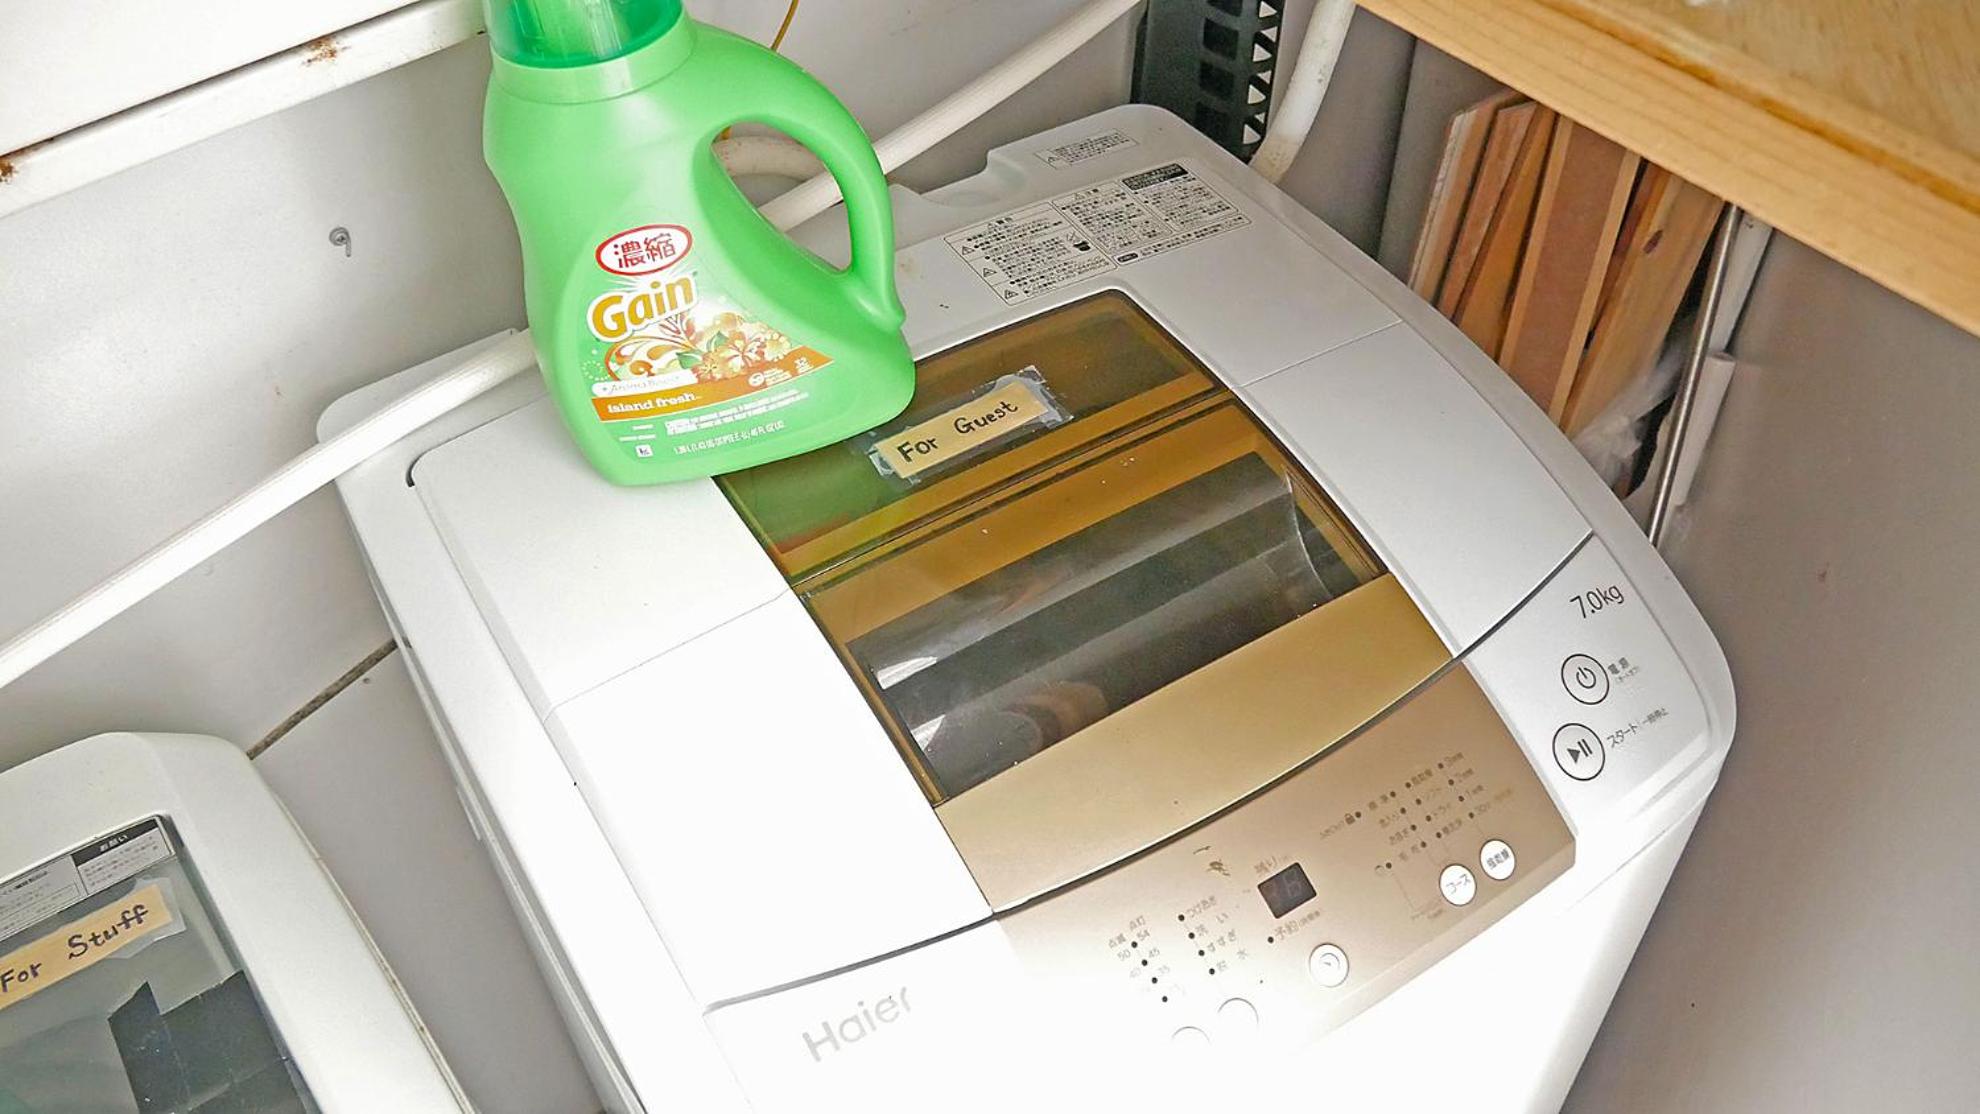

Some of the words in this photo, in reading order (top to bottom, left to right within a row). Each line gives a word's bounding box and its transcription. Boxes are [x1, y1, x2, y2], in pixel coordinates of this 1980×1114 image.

[613, 233, 676, 268] 濃縮
[592, 277, 694, 338] Gain
[897, 437, 938, 463] For
[954, 401, 1018, 434] Guest
[1569, 585, 1625, 619] 7.0kg
[0, 962, 42, 993] For
[68, 904, 149, 960] Stuff
[802, 986, 911, 1062] Haier
